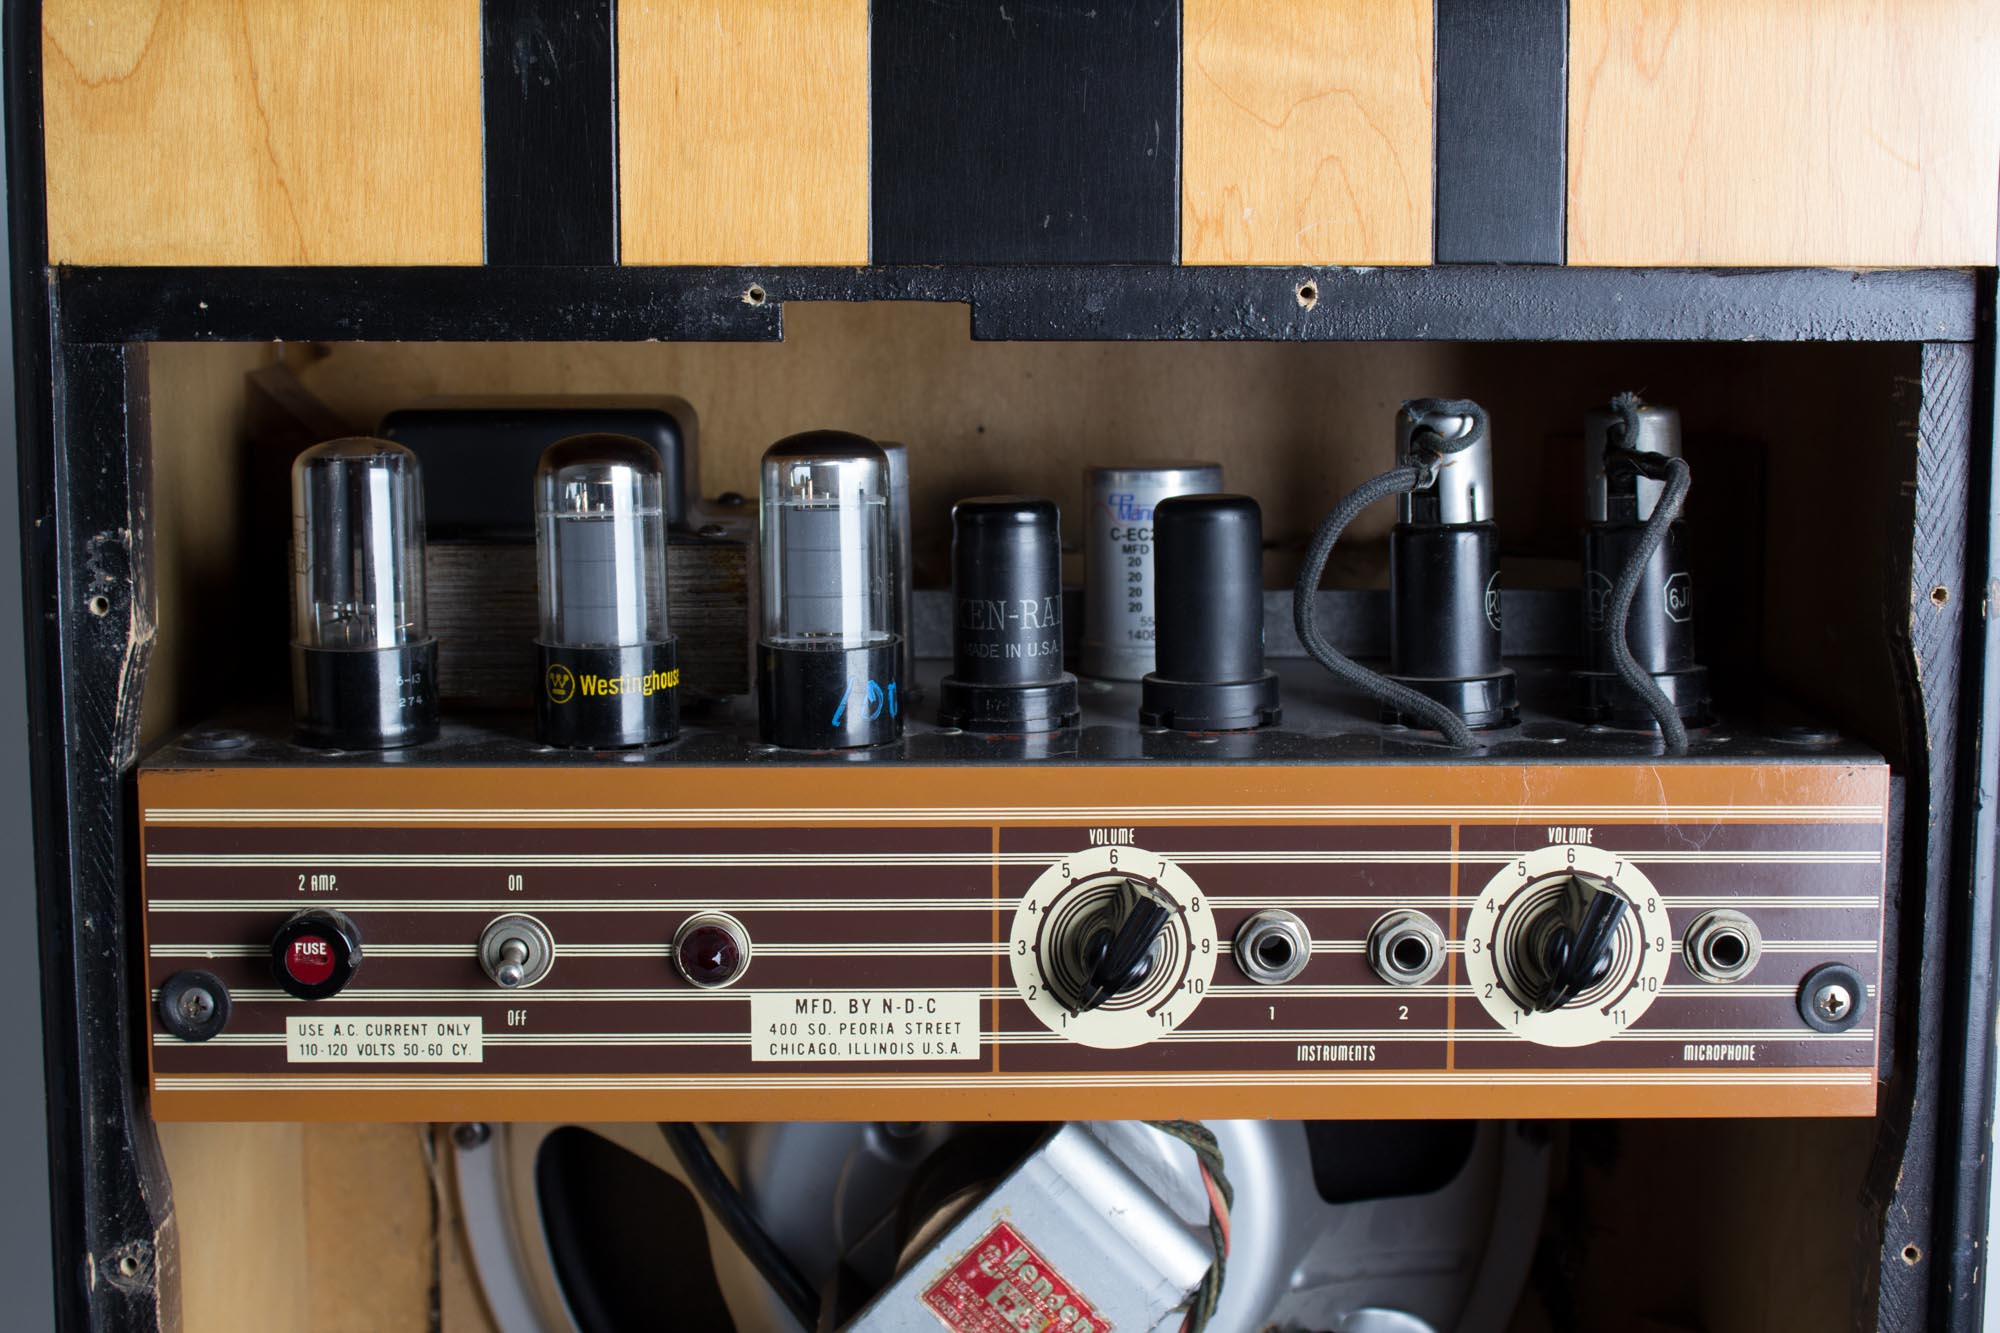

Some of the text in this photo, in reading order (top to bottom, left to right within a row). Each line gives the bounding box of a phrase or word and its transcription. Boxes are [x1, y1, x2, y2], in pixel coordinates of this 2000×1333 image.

[1122, 544, 1149, 554] MFD
[1128, 557, 1142, 567] 20
[1128, 572, 1142, 583] 20
[1128, 587, 1142, 598] 20
[1128, 602, 1142, 613] 20
[1005, 642, 1022, 659] IN
[1089, 828, 1135, 845] VOLUME
[1548, 827, 1594, 844] VOLUME
[1110, 849, 1118, 864] 6
[1567, 848, 1575, 863] 6
[1062, 863, 1070, 878] 5
[1158, 862, 1166, 877] 7
[1518, 861, 1526, 876] 5
[1615, 862, 1623, 876] 7
[298, 874, 339, 891] 2 AMP.
[508, 874, 523, 891] ON
[1028, 900, 1037, 914] 4
[1191, 897, 1200, 912] 8
[1486, 898, 1494, 913] 4
[1647, 898, 1656, 912] 8
[294, 942, 328, 956] FUSE
[1018, 940, 1026, 955] 3
[1201, 939, 1210, 953] 9
[1472, 938, 1481, 953] 3
[1656, 937, 1664, 952] 9
[1187, 979, 1203, 994] 10
[1484, 983, 1492, 998] 2
[1640, 977, 1656, 992] 10
[1029, 985, 1037, 1000] 2
[795, 997, 937, 1015] MFD. BY N-D-C
[1269, 1006, 1275, 1021] 1
[1398, 1005, 1409, 1020] 2
[507, 1009, 527, 1026] OFF
[1061, 1012, 1066, 1028] 1
[1160, 1012, 1173, 1027] 11
[1513, 1010, 1518, 1025] 1
[1613, 1010, 1626, 1025] 11
[298, 1023, 324, 1037] USE
[365, 1023, 428, 1037] CURRENT
[437, 1023, 471, 1037] ONLY
[769, 1022, 961, 1036] 400 SO. PEORIA STREET
[356, 1043, 396, 1057] VOLTS
[452, 1043, 472, 1057] CY.
[848, 1042, 915, 1056] ILLINOIS
[922, 1041, 962, 1055] U.S.A.
[1297, 1045, 1376, 1062] INSTRUMENTS
[1683, 1044, 1756, 1061] MICROPHONE
